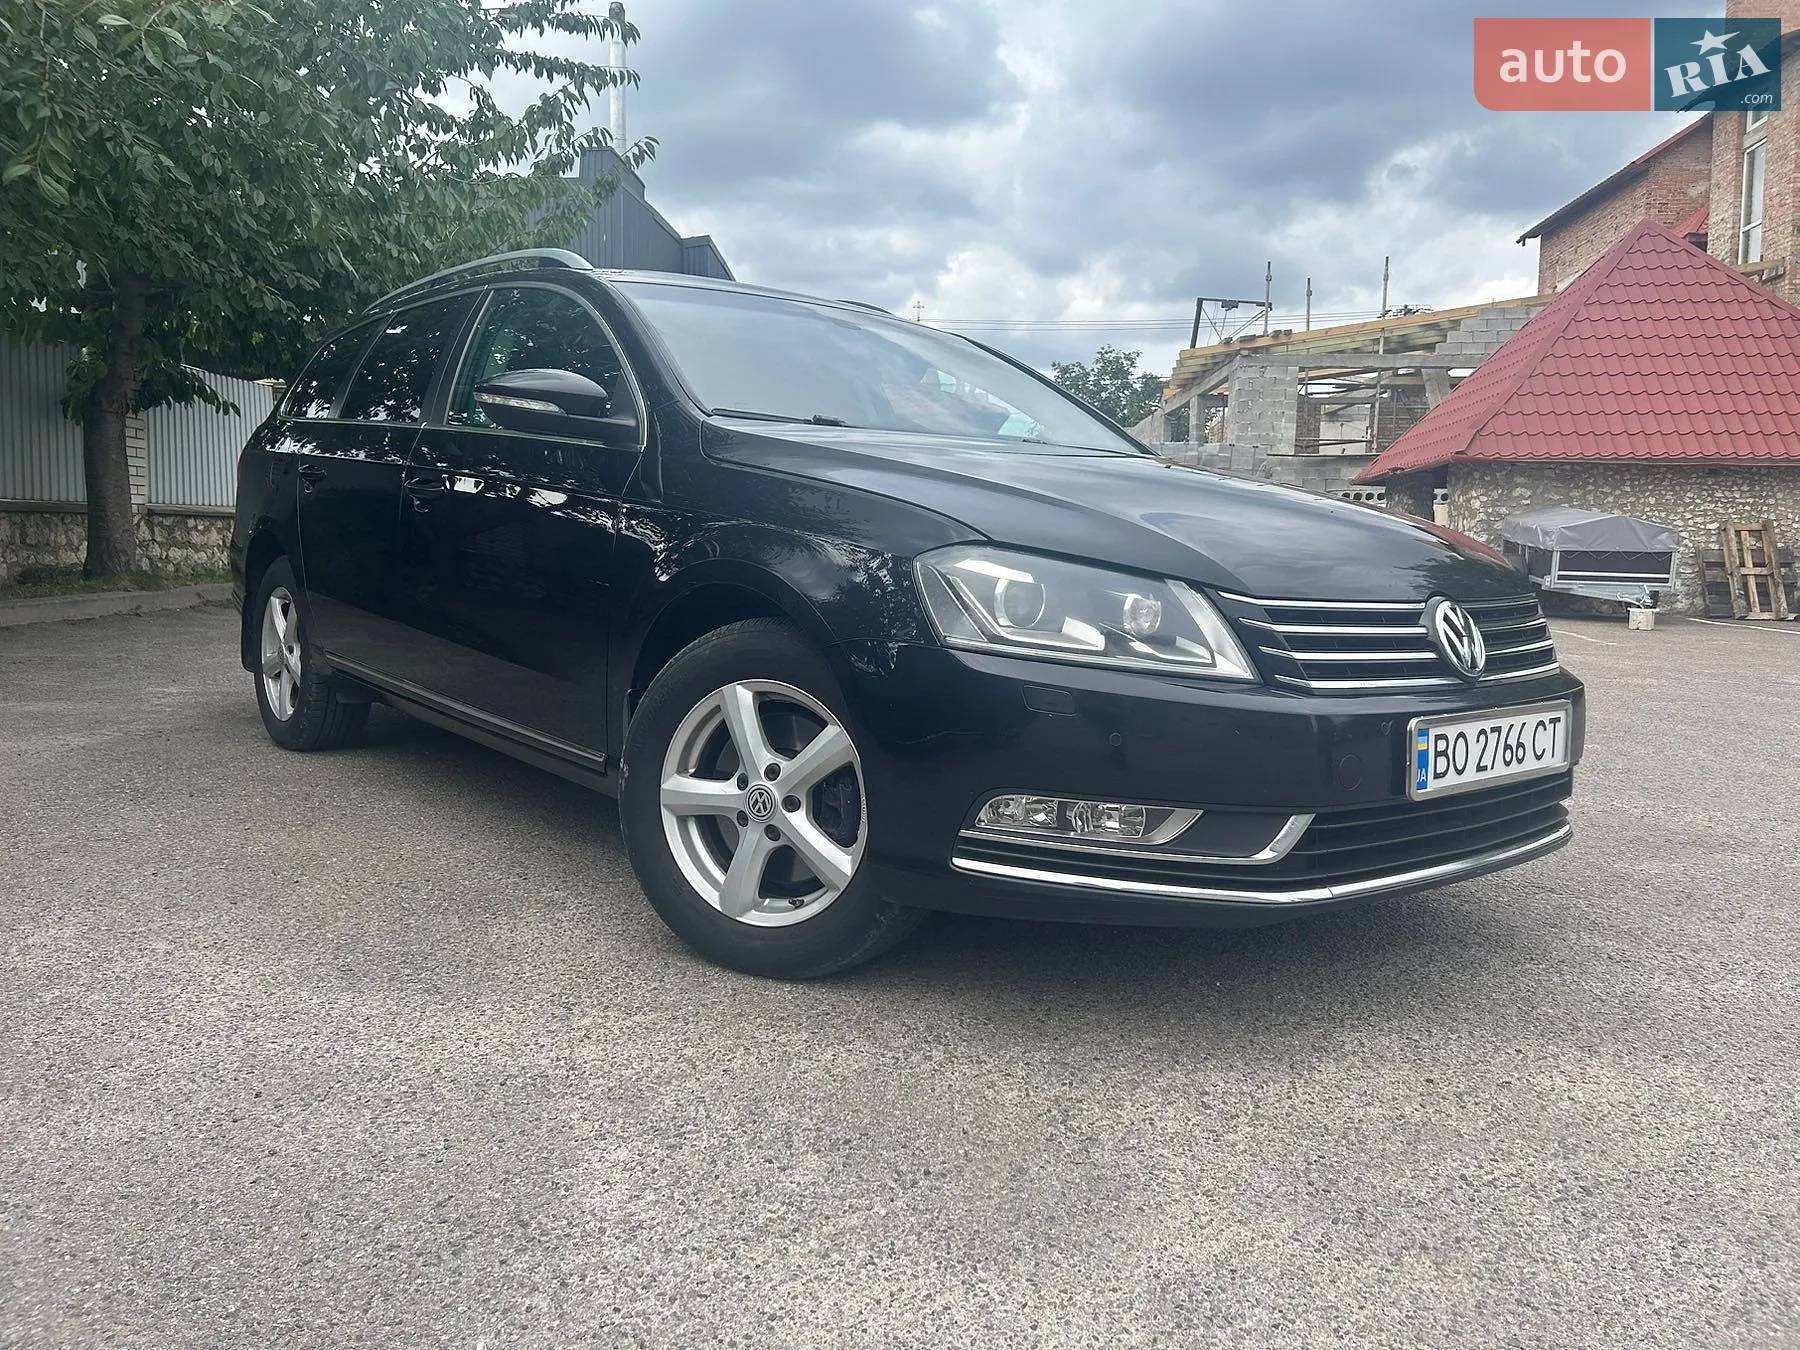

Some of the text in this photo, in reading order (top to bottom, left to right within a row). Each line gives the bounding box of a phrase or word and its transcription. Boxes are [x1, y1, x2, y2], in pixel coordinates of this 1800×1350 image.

[1433, 716, 1562, 780] BO 2766 CT
